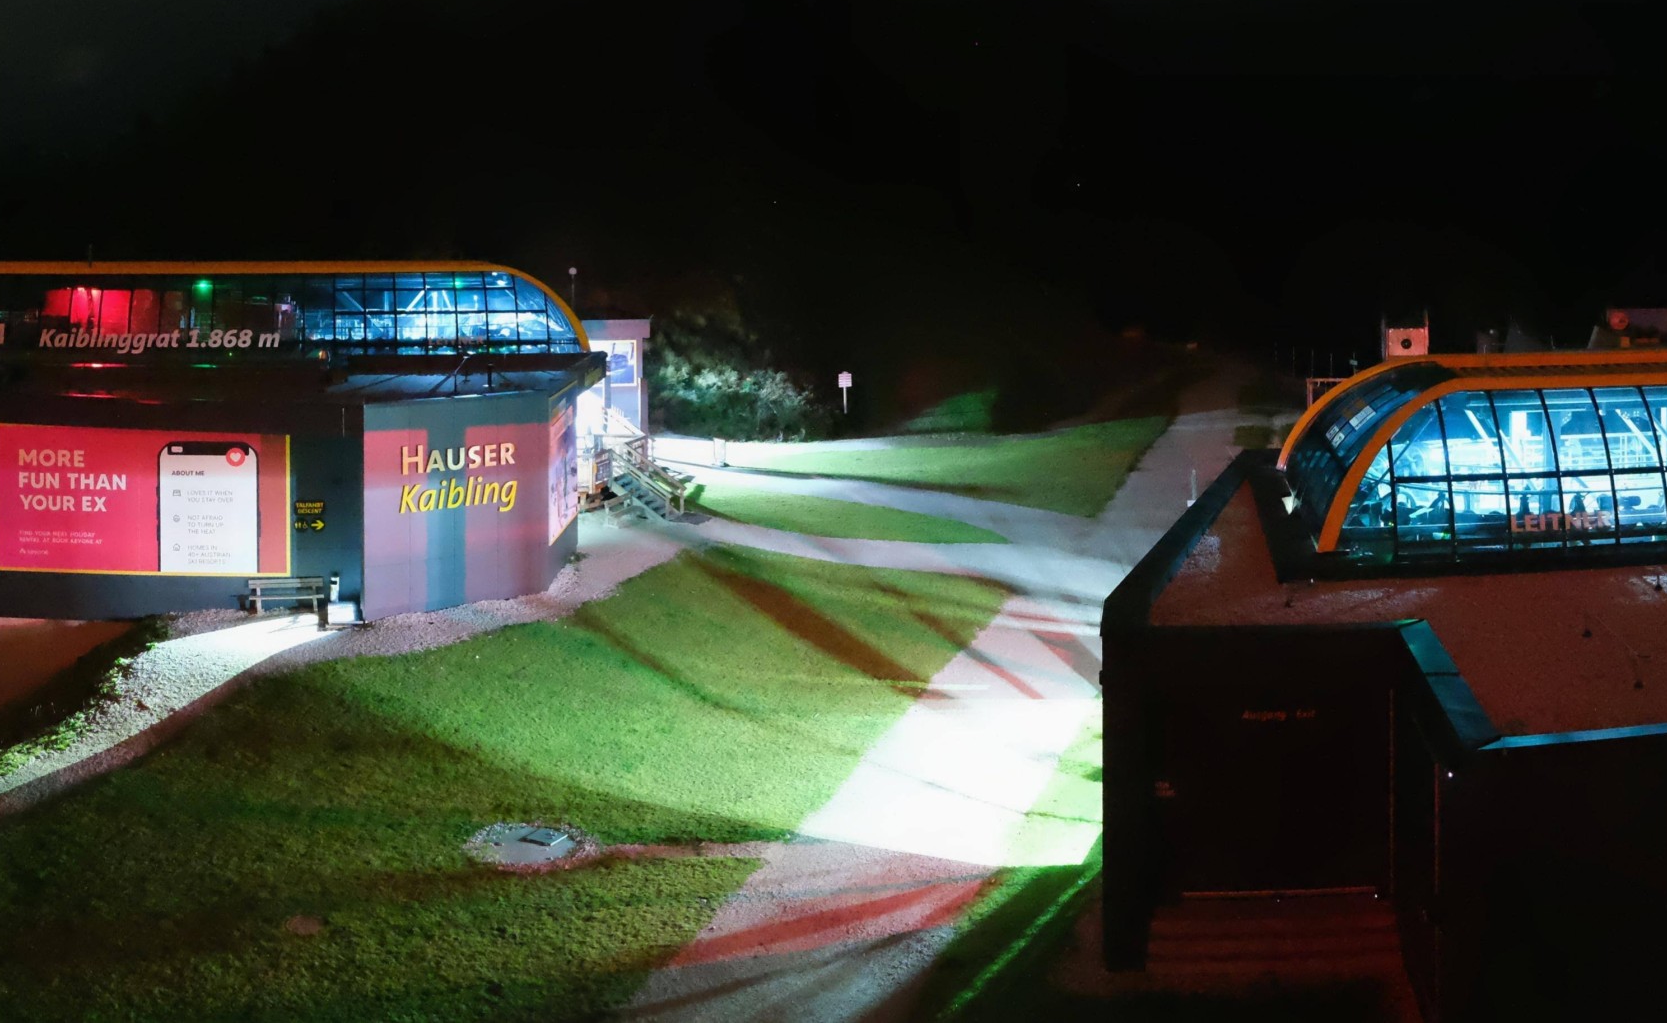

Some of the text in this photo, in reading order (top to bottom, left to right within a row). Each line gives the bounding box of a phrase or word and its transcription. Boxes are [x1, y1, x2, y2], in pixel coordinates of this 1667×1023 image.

[39, 329, 281, 355] Kaiblinggrat 1.868 m
[18, 449, 85, 468] MORE
[401, 442, 516, 475] HAUSER
[18, 472, 127, 491] FUN THAN
[20, 495, 107, 512] YOUR EX
[399, 476, 518, 514] Kaibling
[1510, 510, 1612, 532] LEITNER
